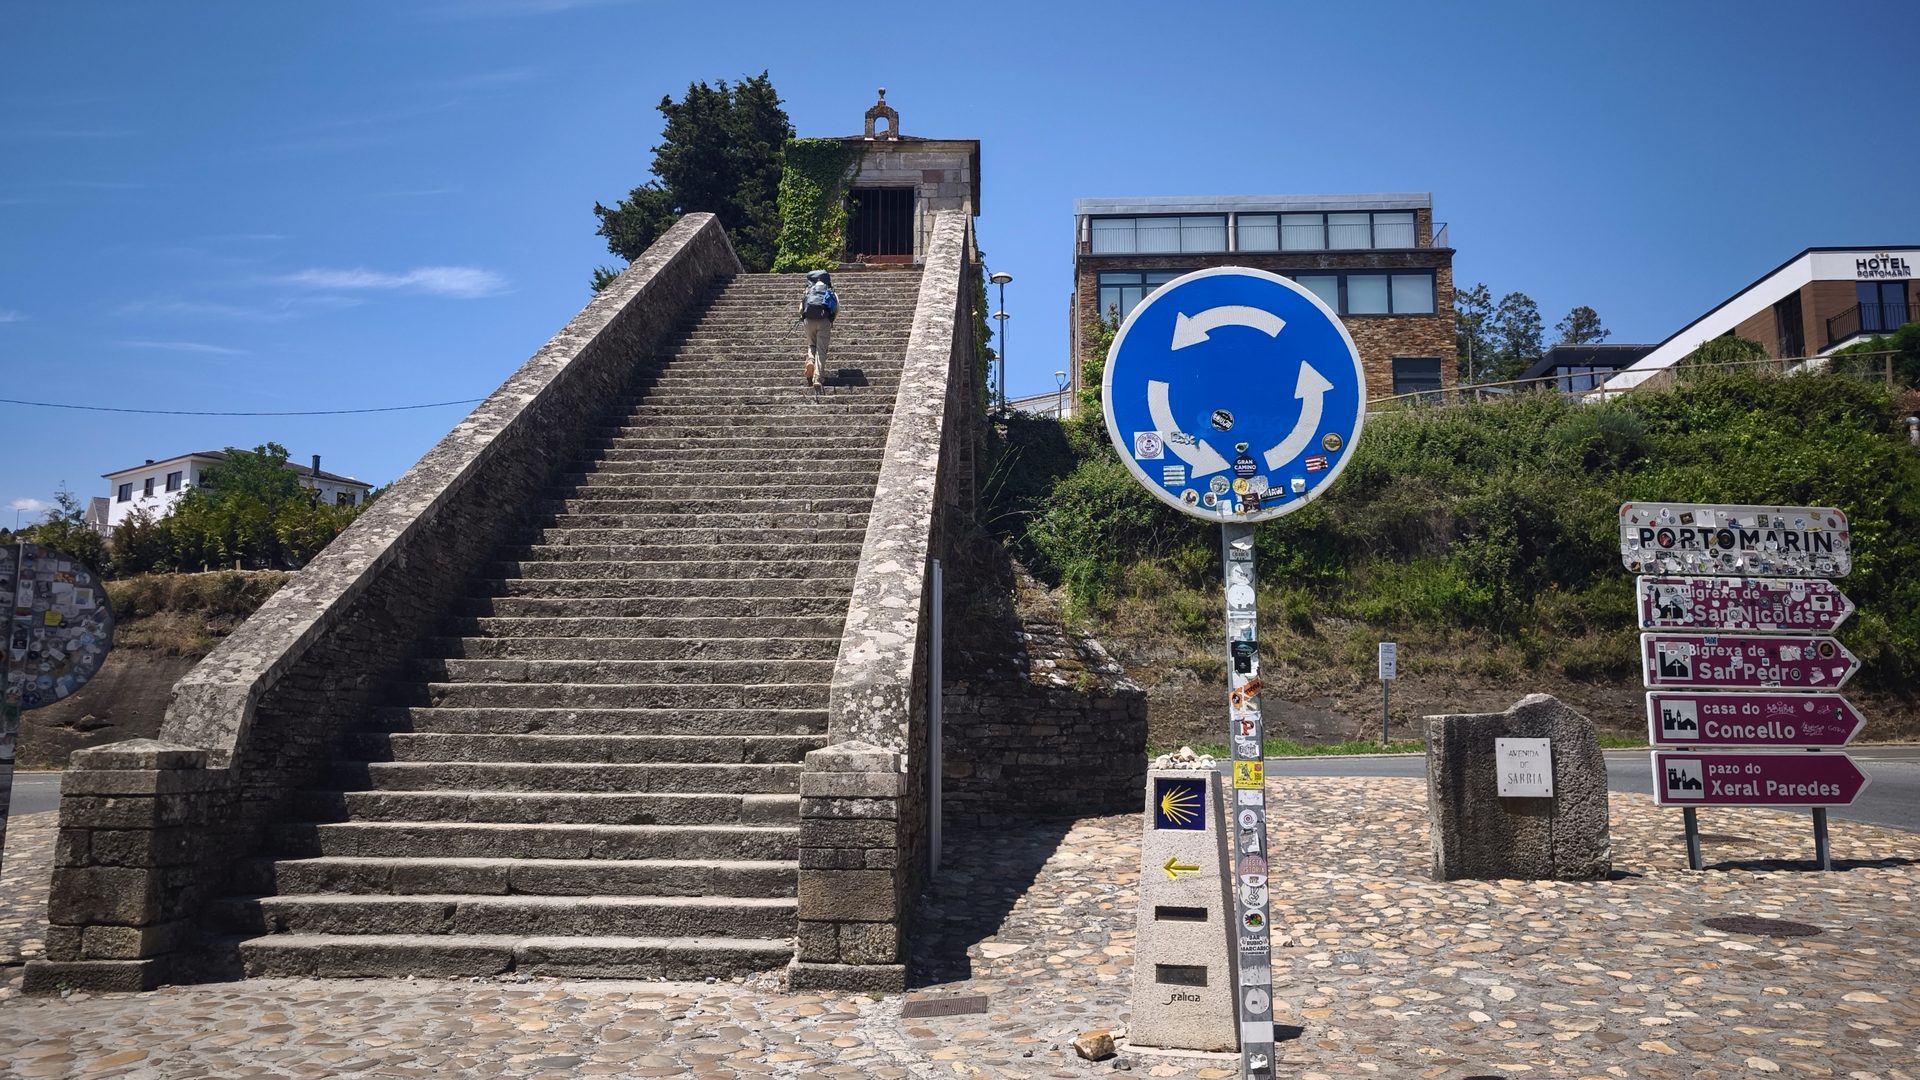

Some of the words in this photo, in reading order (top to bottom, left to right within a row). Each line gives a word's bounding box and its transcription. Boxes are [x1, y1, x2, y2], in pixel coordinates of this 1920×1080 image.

[1856, 258, 1910, 270] HOTEL
[1743, 587, 1760, 599] de
[1748, 645, 1766, 657] de
[1699, 662, 1736, 680] San
[1703, 704, 1736, 715] casa
[1742, 702, 1760, 715] do
[1704, 721, 1796, 739] Concello
[1709, 764, 1740, 776] pazo
[1745, 763, 1762, 774] do
[1711, 779, 1760, 796] Xeral
[1766, 780, 1841, 797] Paredes
